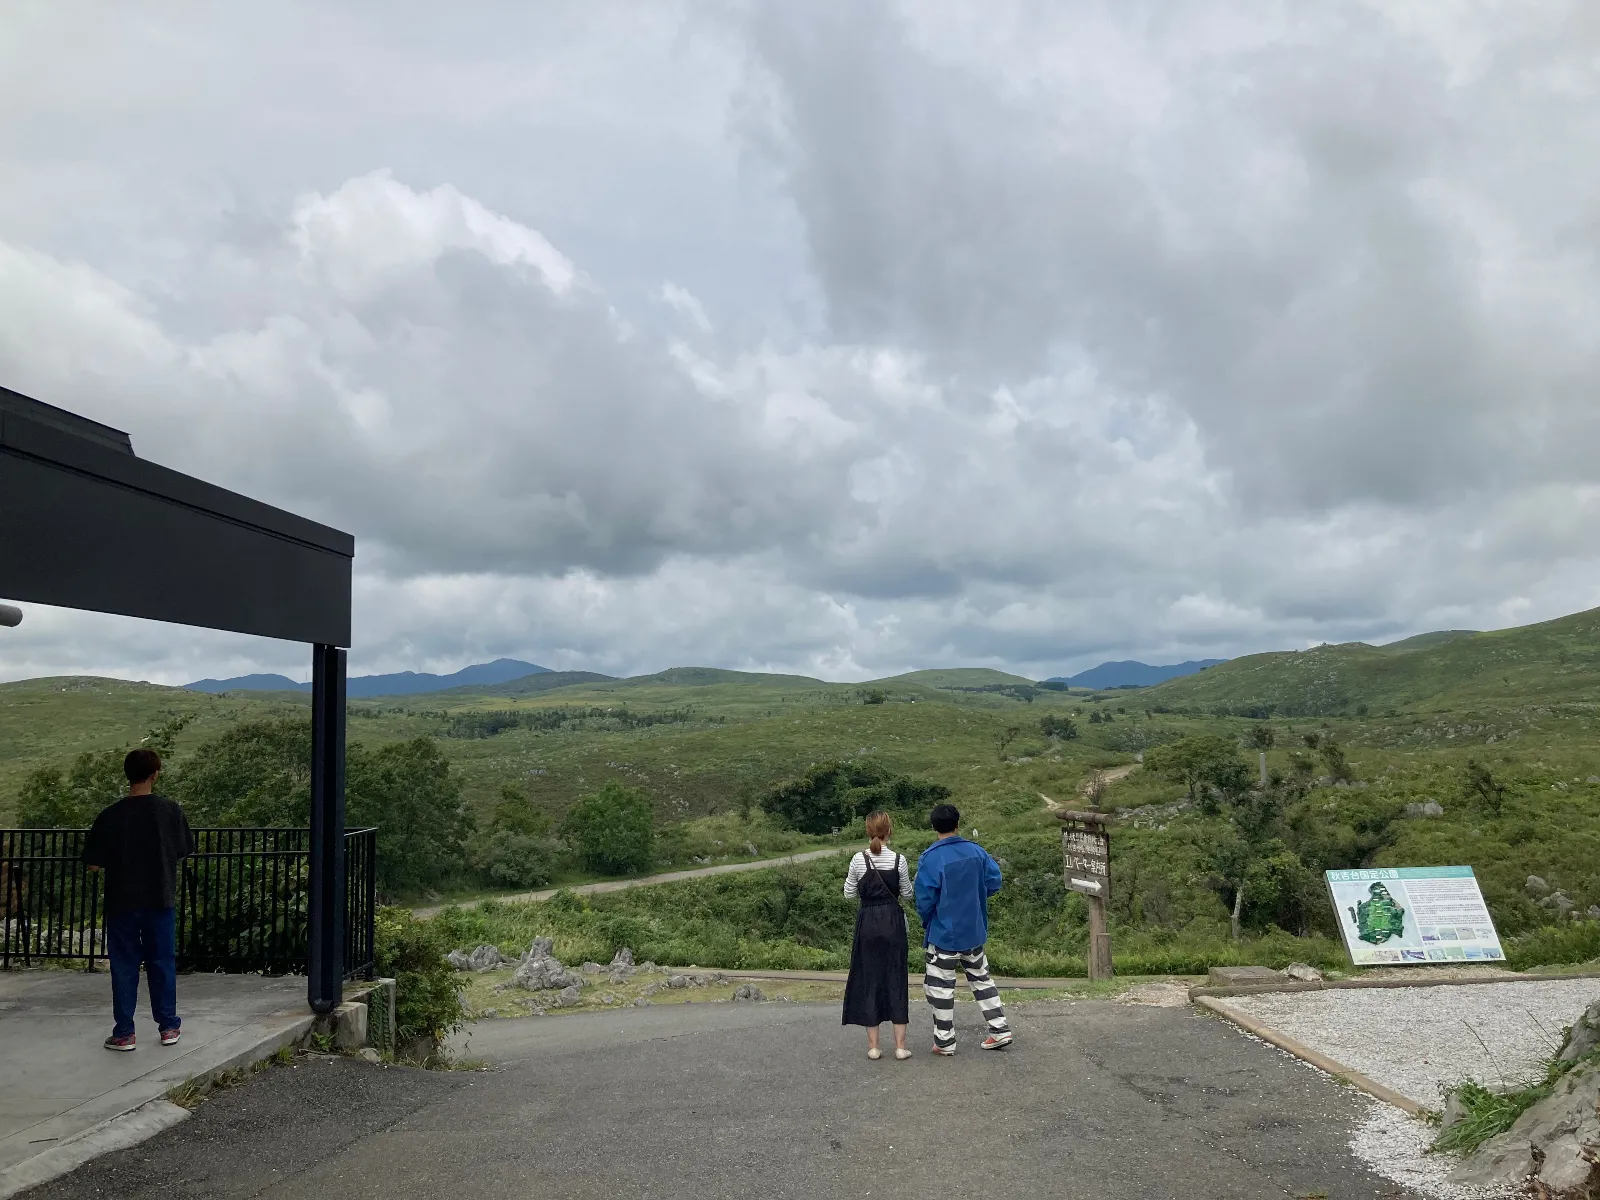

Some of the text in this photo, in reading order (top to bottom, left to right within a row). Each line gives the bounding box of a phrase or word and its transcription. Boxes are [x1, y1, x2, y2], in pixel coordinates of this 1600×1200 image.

[1331, 869, 1399, 880] 秋吉台国定公園
